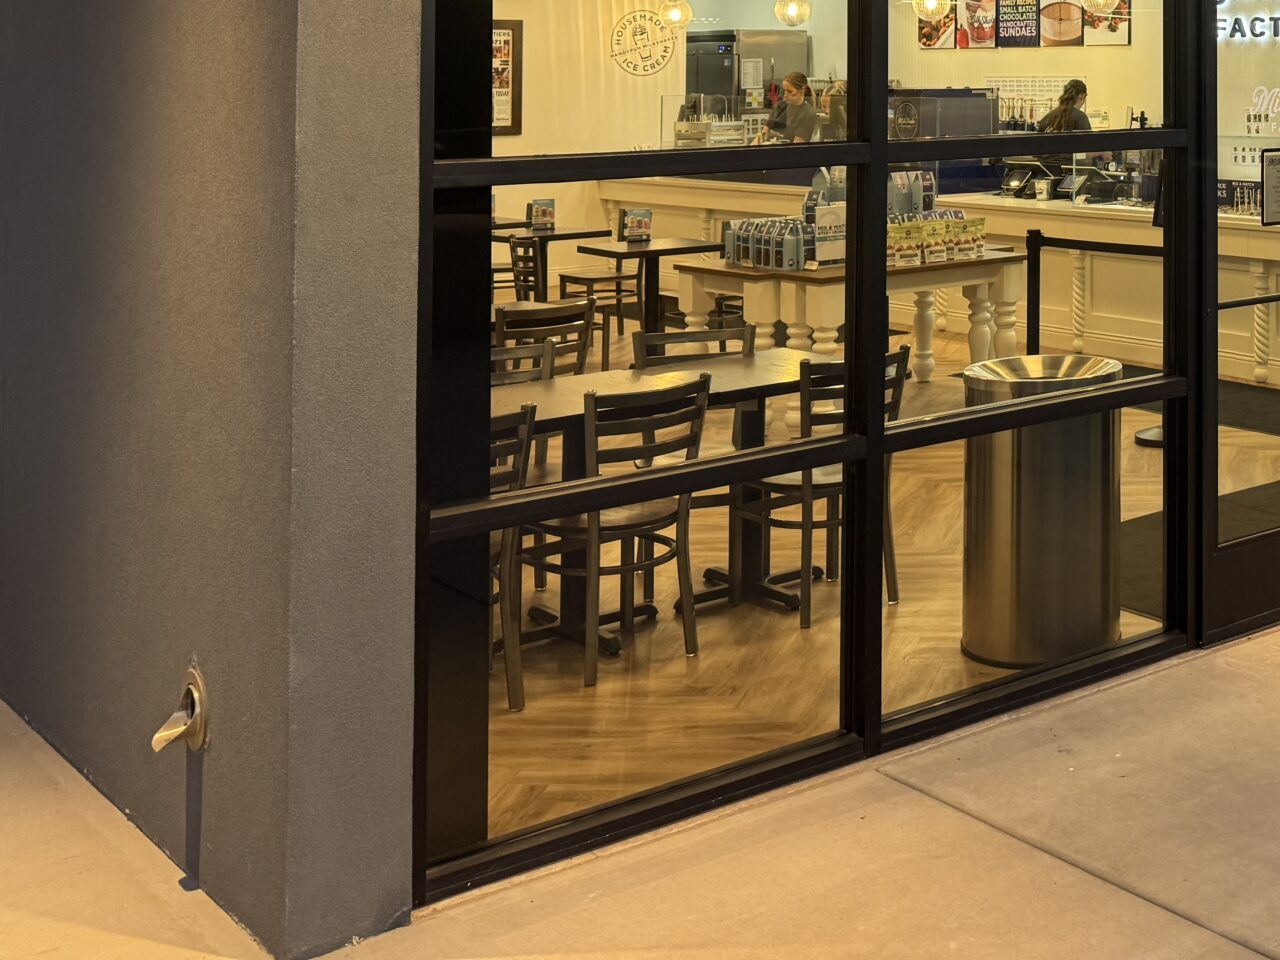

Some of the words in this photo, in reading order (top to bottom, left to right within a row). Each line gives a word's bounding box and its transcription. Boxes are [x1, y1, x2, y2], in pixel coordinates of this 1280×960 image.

[1000, 12, 1037, 20] CHOCOLATES
[615, 14, 667, 46] HOUSEMADE
[1000, 27, 1037, 37] SUNDAES
[622, 58, 639, 71] ICE
[642, 46, 670, 72] CREAM
